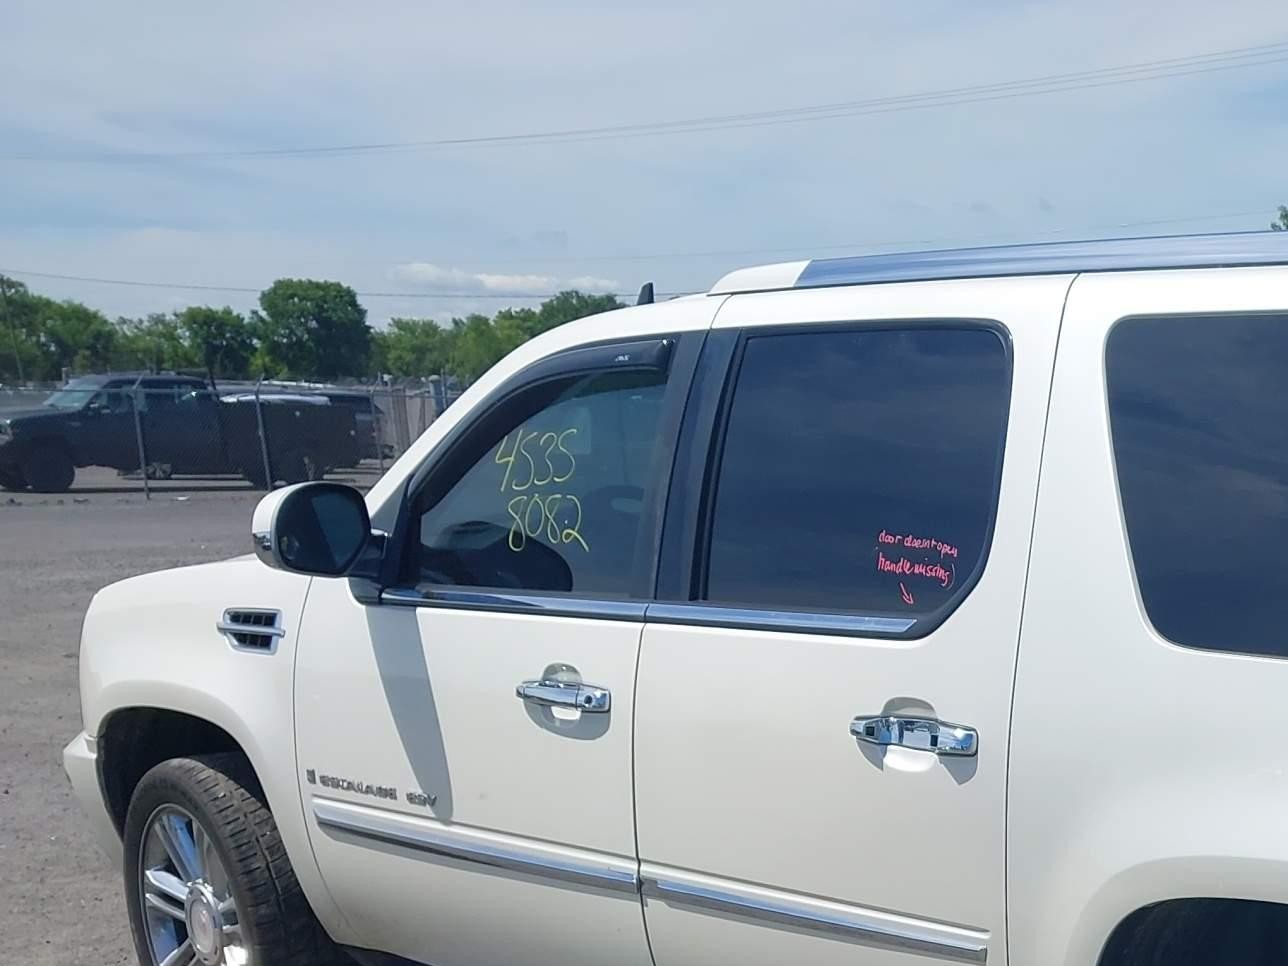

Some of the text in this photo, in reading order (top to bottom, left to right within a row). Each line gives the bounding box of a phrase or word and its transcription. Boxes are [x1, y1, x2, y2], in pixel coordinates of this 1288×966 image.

[495, 429, 578, 492] 4535
[508, 493, 590, 552] 8082
[878, 529, 902, 545] door
[877, 551, 914, 575] handle
